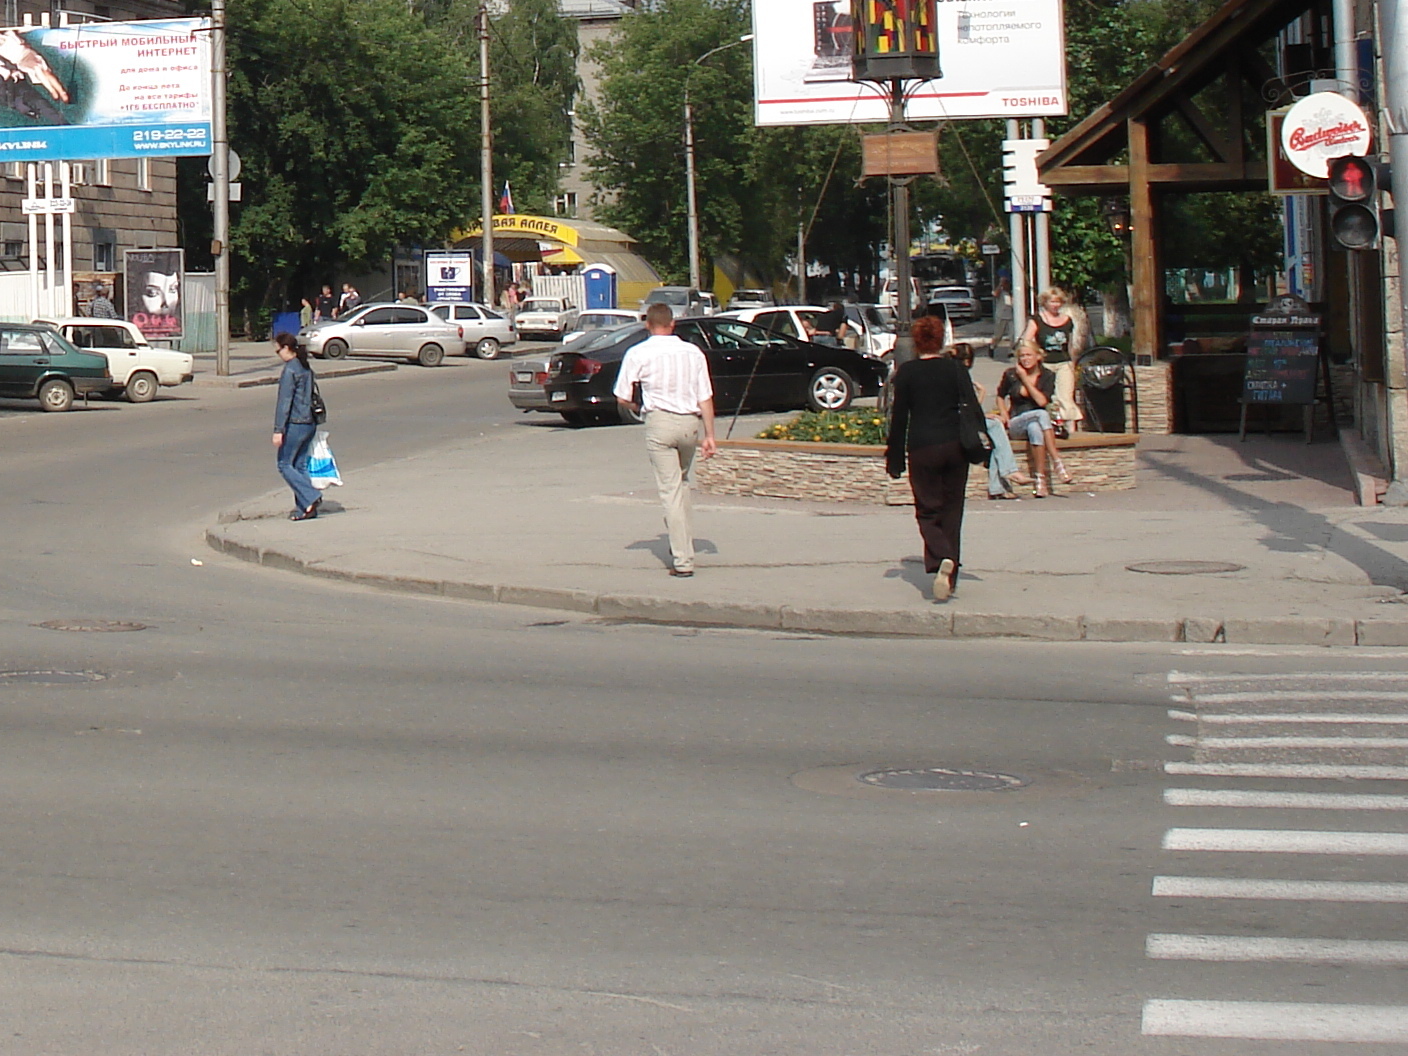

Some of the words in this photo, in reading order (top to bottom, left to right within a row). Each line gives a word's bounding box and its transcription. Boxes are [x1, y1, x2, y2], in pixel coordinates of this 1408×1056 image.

[60, 39, 118, 50] БЫСТРЫЙ
[121, 34, 198, 47] МОБИЛЬНЫЙ
[137, 46, 198, 58] ИНТЕРНЕТ
[1002, 96, 1060, 107] TOSHIBA
[133, 128, 206, 141] 219-22-22
[520, 218, 559, 235] АЛЛЕЯ
